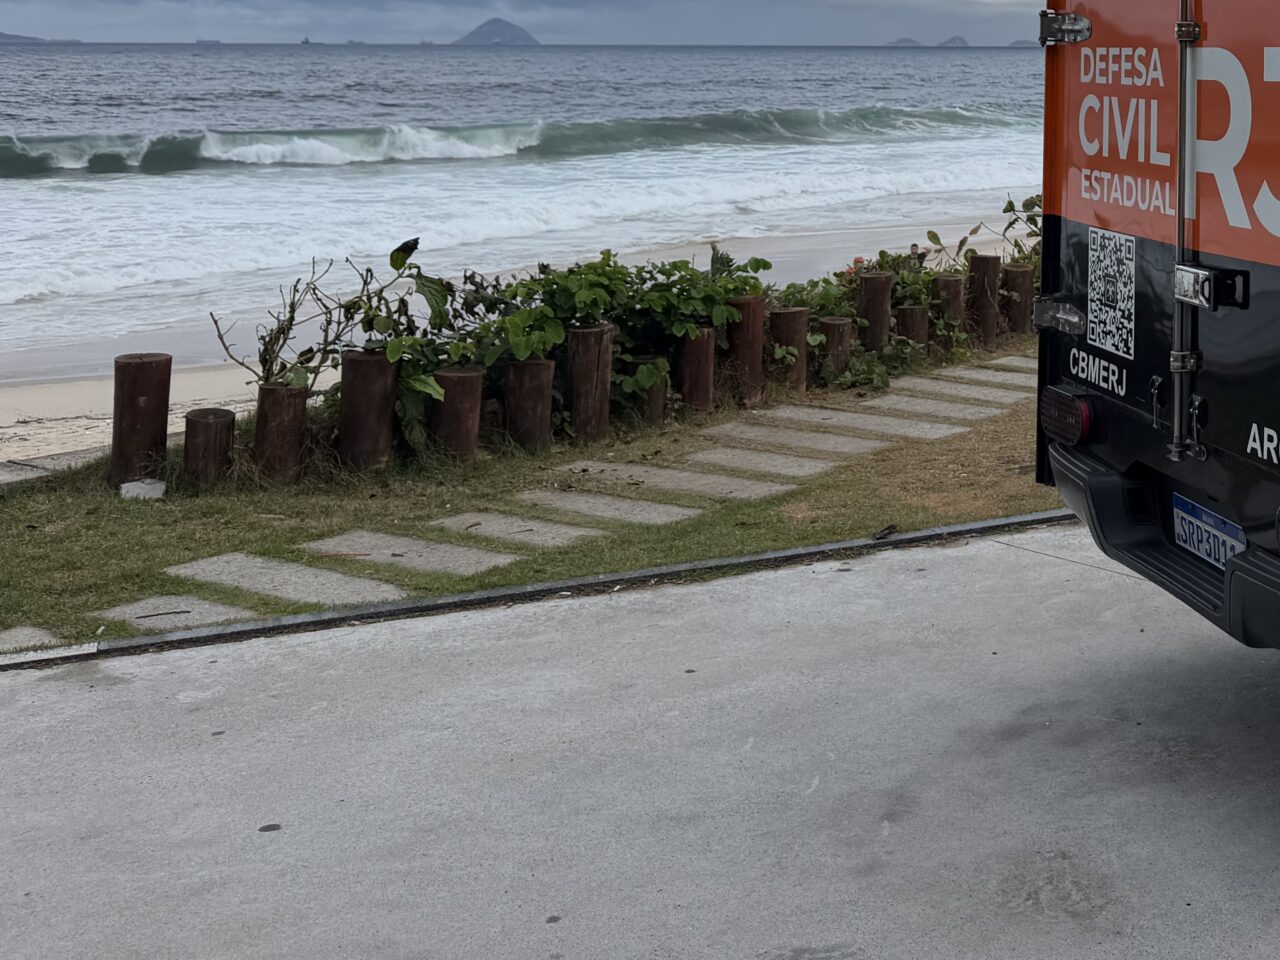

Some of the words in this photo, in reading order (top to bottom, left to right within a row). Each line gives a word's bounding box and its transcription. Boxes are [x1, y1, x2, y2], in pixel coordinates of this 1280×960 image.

[1080, 46, 1164, 87] DEFESA
[1078, 94, 1171, 166] CIVIL
[1081, 168, 1176, 216] ESTADUAL
[1069, 347, 1127, 397] CBMERJ
